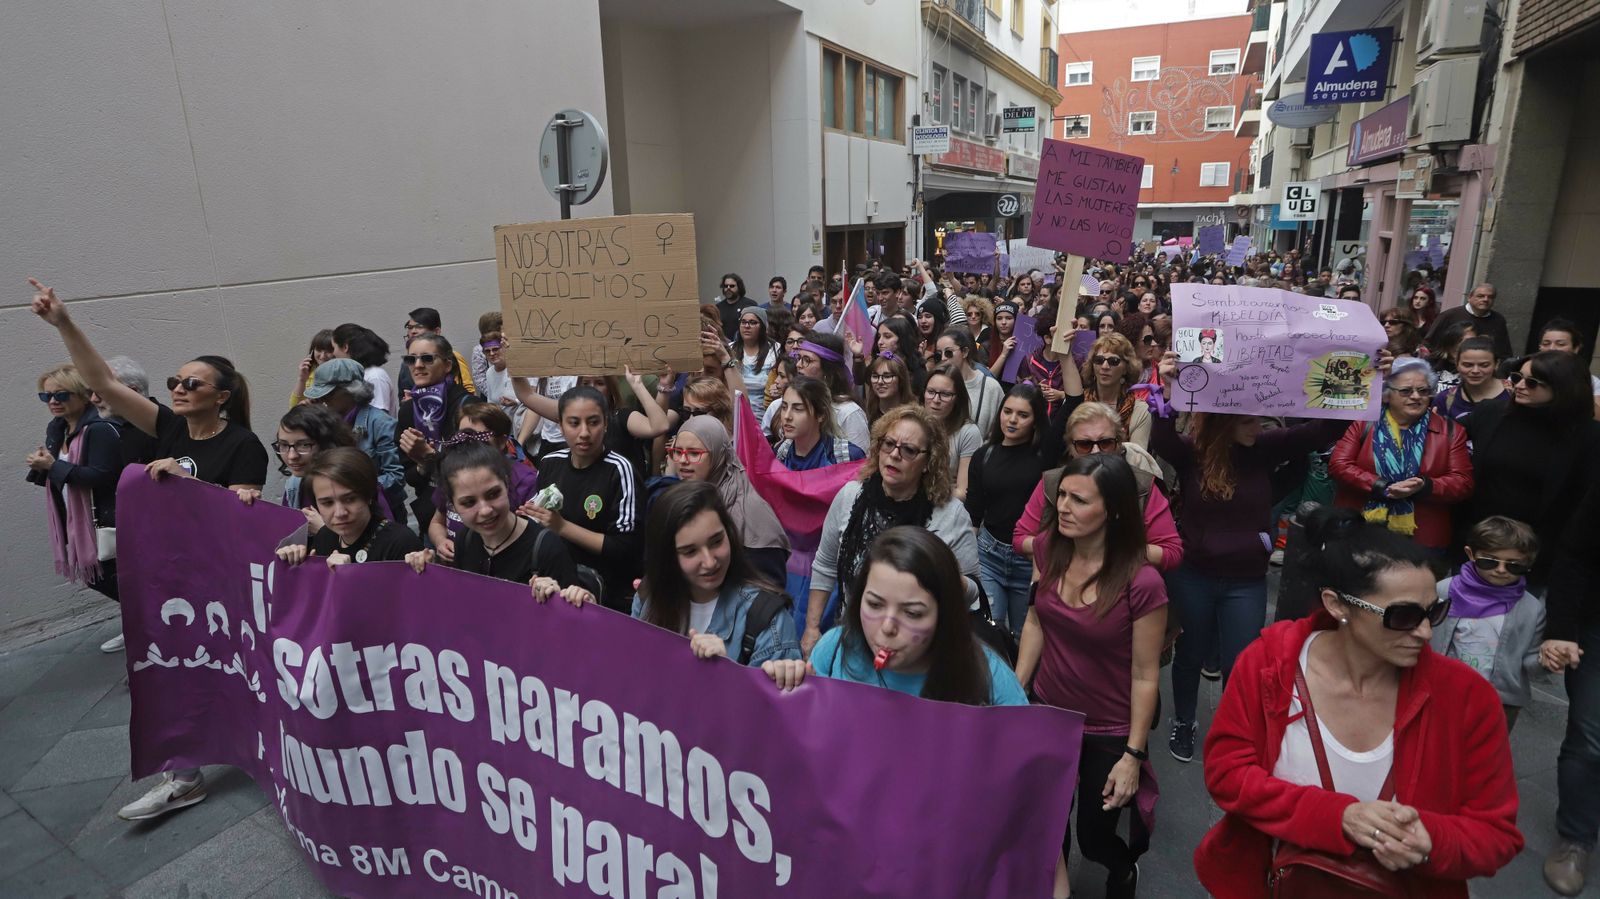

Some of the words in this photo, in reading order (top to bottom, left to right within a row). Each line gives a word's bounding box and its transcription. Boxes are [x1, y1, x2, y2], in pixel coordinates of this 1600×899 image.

[1312, 90, 1376, 100] seguros
[1314, 79, 1378, 93] Almudena
[1004, 111, 1020, 119] DEL
[1022, 110, 1035, 118] PIE
[1360, 124, 1392, 154] Almudena
[1042, 144, 1058, 160] A
[1069, 148, 1091, 167] MI
[1096, 154, 1142, 175] TAMBIÉN
[1046, 169, 1067, 187] ME
[1073, 175, 1127, 194] GUSTAN
[1045, 189, 1073, 206] LAS
[1077, 195, 1135, 218] MUJERES
[1036, 211, 1045, 226] Y
[1051, 215, 1066, 228] NO
[1069, 218, 1091, 231] LAS
[1097, 221, 1132, 240] VIOLO
[504, 225, 631, 269] NOSOTRAS
[511, 271, 648, 301] DECIDIMOS
[661, 273, 676, 298] Y
[643, 313, 679, 338] OS
[1175, 339, 1195, 353] CAN
[1227, 344, 1295, 363] LIBERTAD
[484, 658, 793, 887] paramos,
[477, 761, 538, 853] se
[352, 846, 412, 877] 8M
